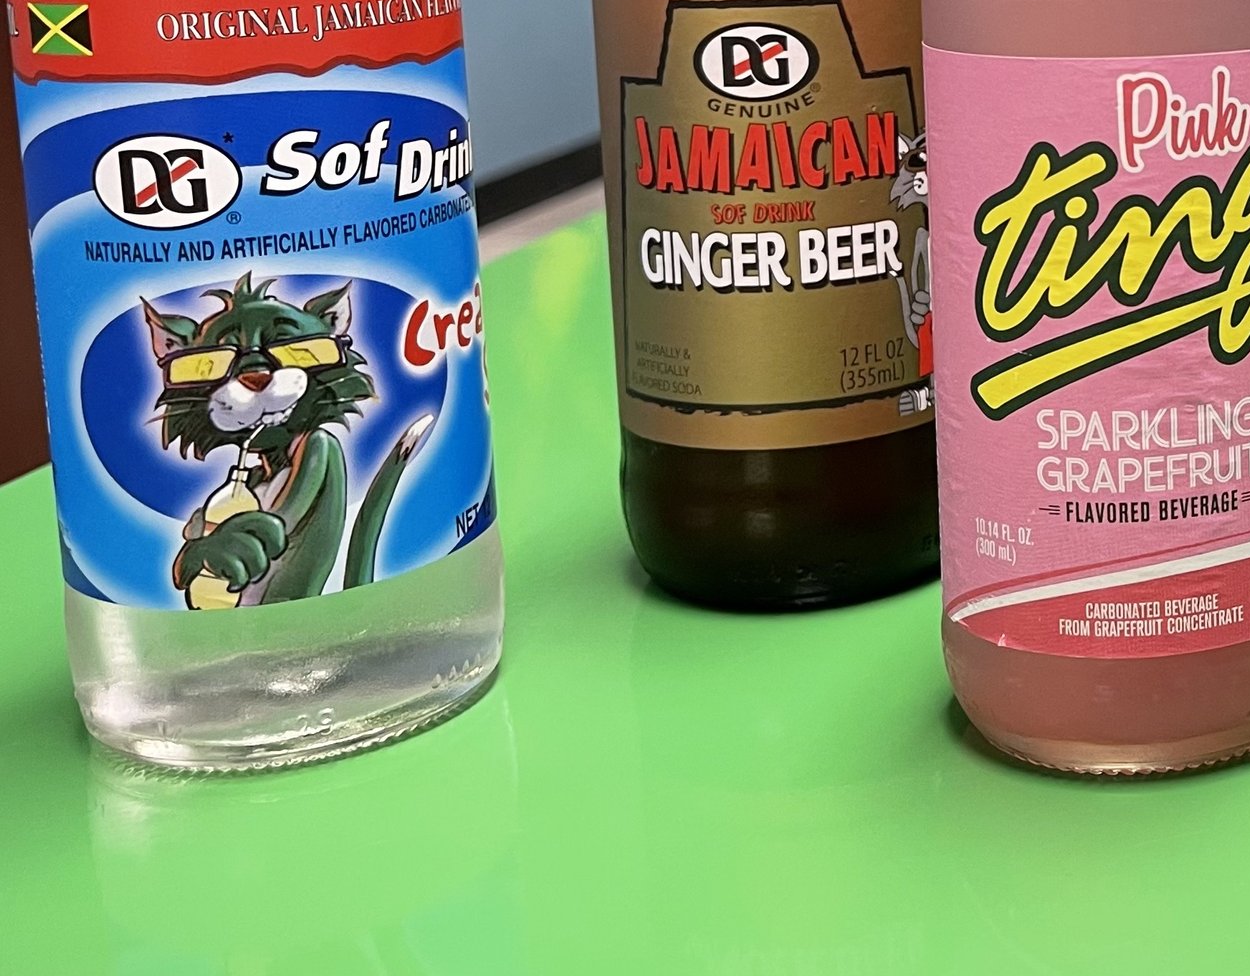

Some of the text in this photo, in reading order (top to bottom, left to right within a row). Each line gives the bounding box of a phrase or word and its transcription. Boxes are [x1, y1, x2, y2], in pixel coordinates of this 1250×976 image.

[156, 6, 307, 43] ORIGINAL
[720, 34, 789, 88] DG
[707, 90, 816, 119] GENUINE
[259, 119, 392, 197] Sof
[634, 110, 901, 196] JAMAICAN
[118, 148, 209, 215] DG
[710, 199, 816, 225] SOF DRINK
[84, 238, 172, 264] NATURALLY
[176, 238, 215, 263] AND
[219, 226, 338, 262] ARTIFICIALLY
[342, 210, 418, 252] FLAVORED
[640, 219, 904, 292] GINGER BEER
[683, 348, 692, 361] &
[840, 338, 905, 368] 12 FL OZ
[672, 381, 703, 396] SODA
[839, 363, 906, 394] (355mL)
[1065, 488, 1239, 526] FLAVORED BEVERAGE
[973, 515, 1035, 548] 10.14 FL. OZ.
[975, 536, 1017, 567] (300 mL)
[1058, 604, 1245, 638] FROM GRAPEFRUIT CONCENTRATE
[1084, 593, 1220, 621] CARBONATED BEVERAGE
